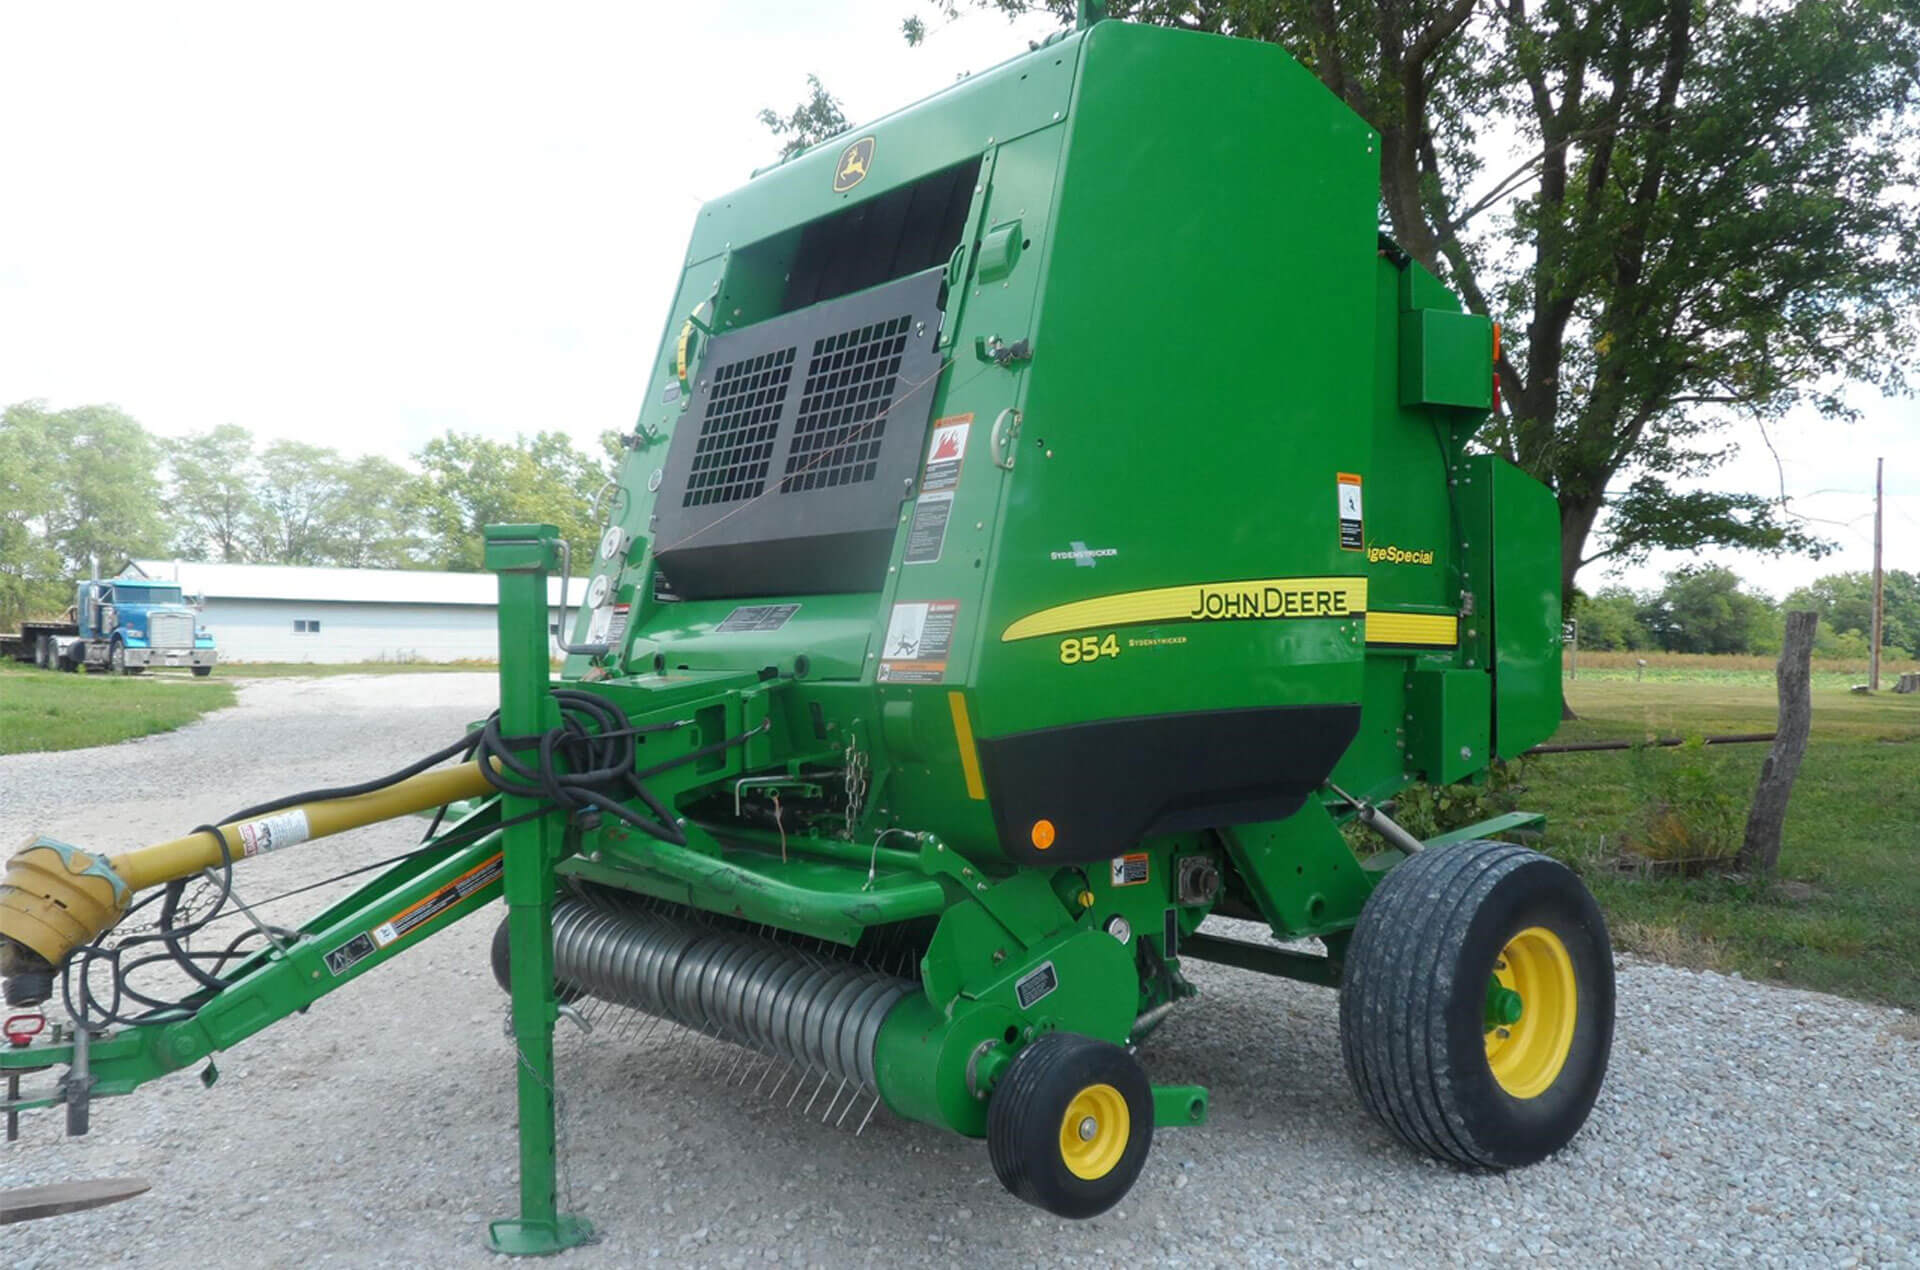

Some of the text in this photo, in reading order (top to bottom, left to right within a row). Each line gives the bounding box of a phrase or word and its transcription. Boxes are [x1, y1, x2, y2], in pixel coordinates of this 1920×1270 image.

[1191, 587, 1347, 616] JOHN DEERE
[1060, 633, 1120, 664] 854
